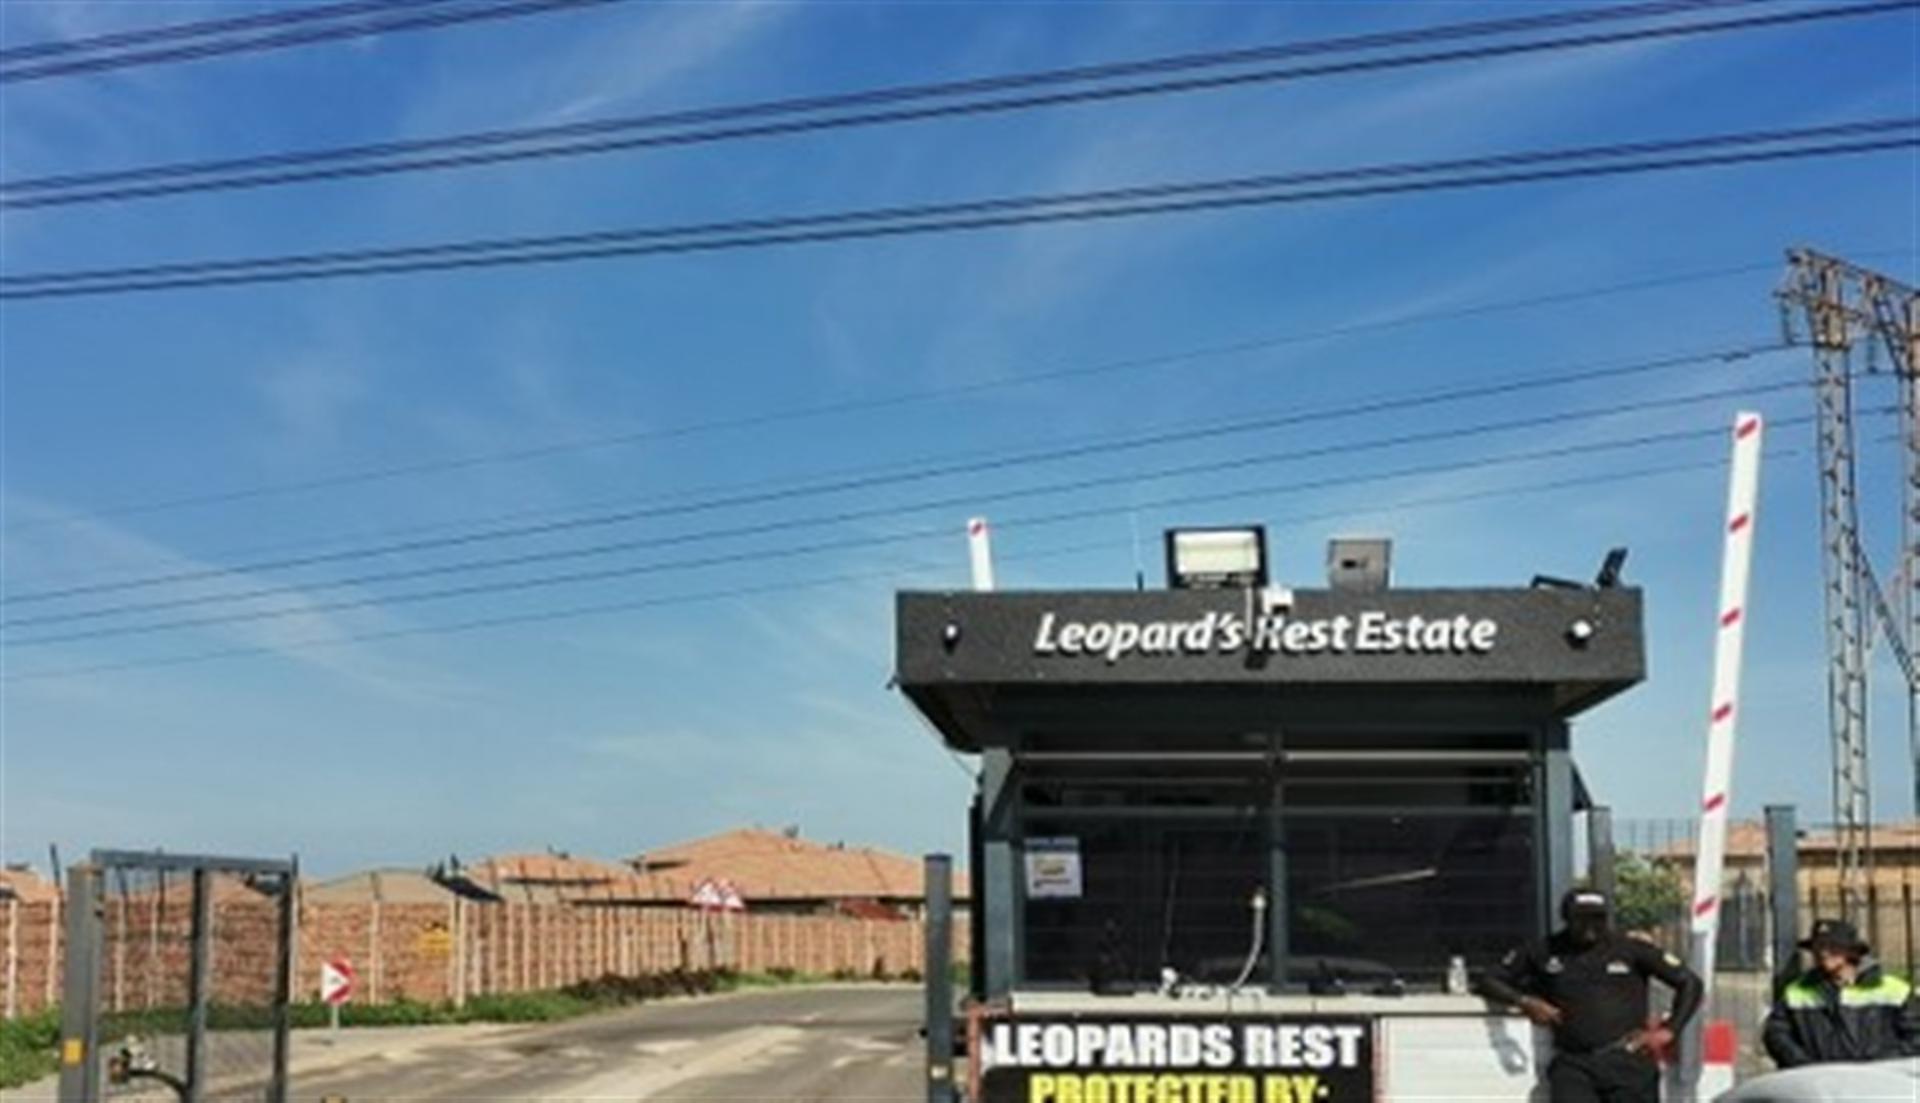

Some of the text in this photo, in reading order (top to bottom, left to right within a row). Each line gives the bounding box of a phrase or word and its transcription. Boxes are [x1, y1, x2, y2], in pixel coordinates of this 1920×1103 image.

[1034, 612, 1497, 662] Leopard's Rest Estate
[994, 1024, 1363, 1066] LEOPARDS REST
[1031, 1074, 1256, 1103] PROTECTED
